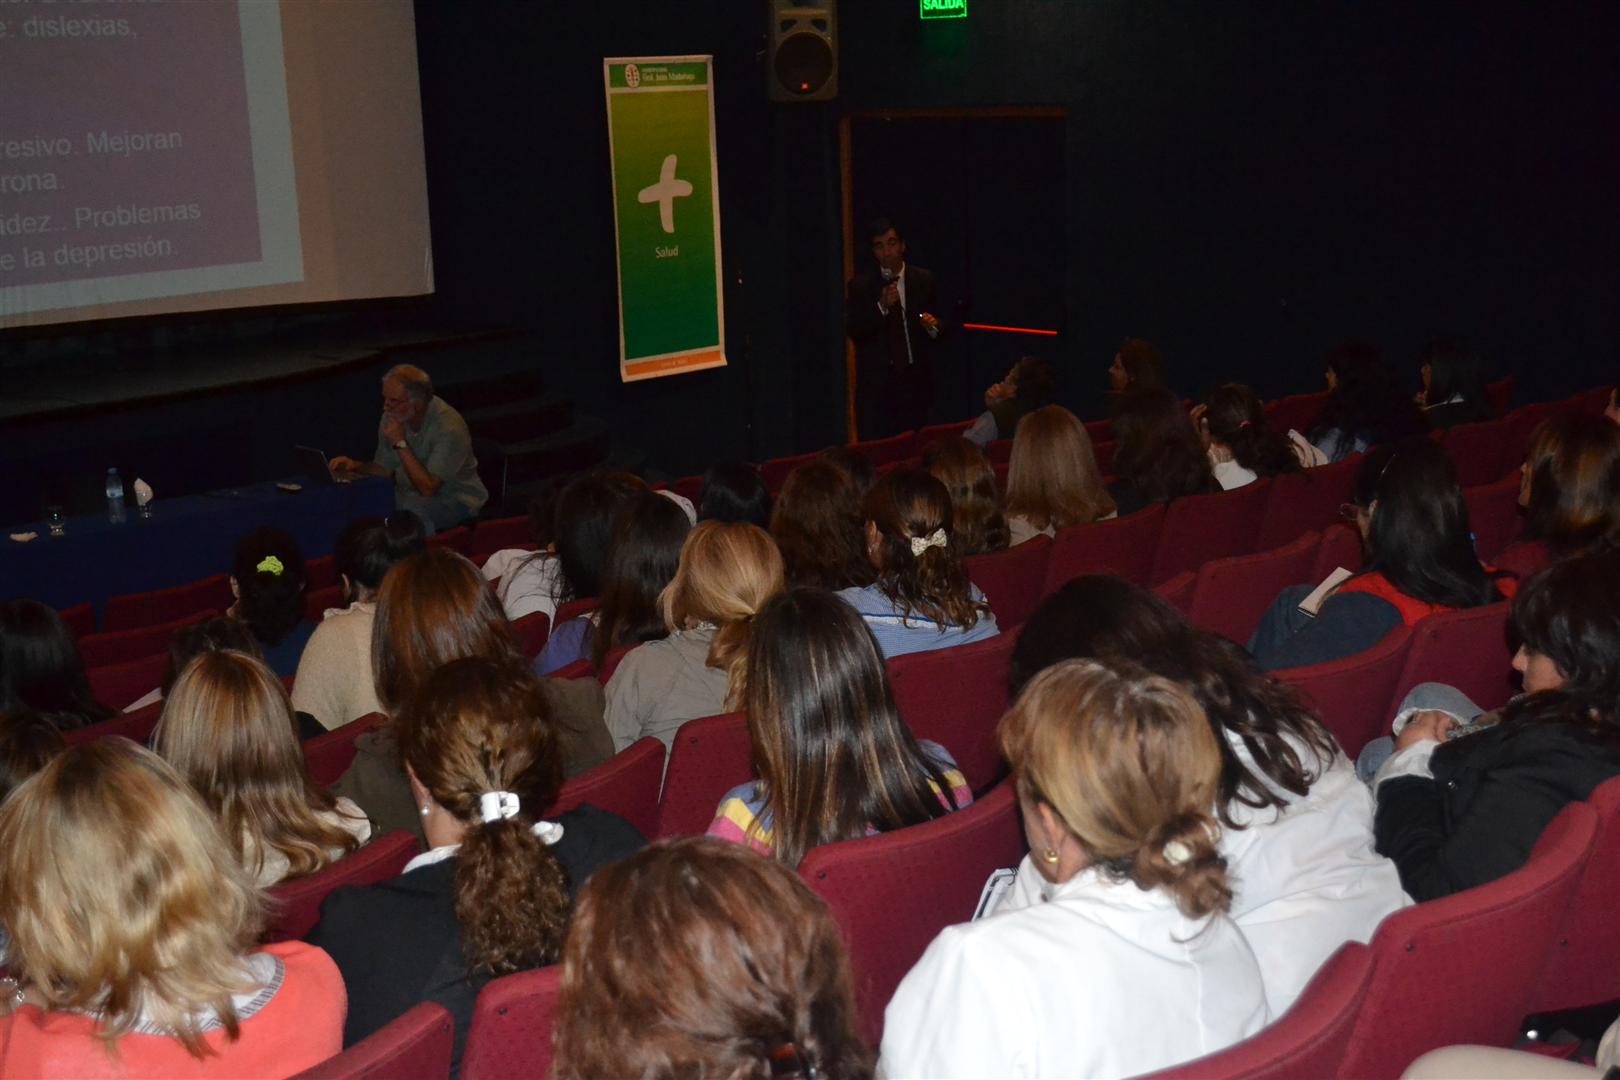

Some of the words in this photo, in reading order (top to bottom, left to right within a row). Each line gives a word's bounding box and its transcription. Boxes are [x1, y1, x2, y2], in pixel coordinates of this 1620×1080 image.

[923, 0, 964, 10] SALIDA
[86, 129, 183, 157] Mejoran
[74, 202, 201, 229] Problemas
[23, 246, 46, 268] la
[655, 245, 680, 259] Salud
